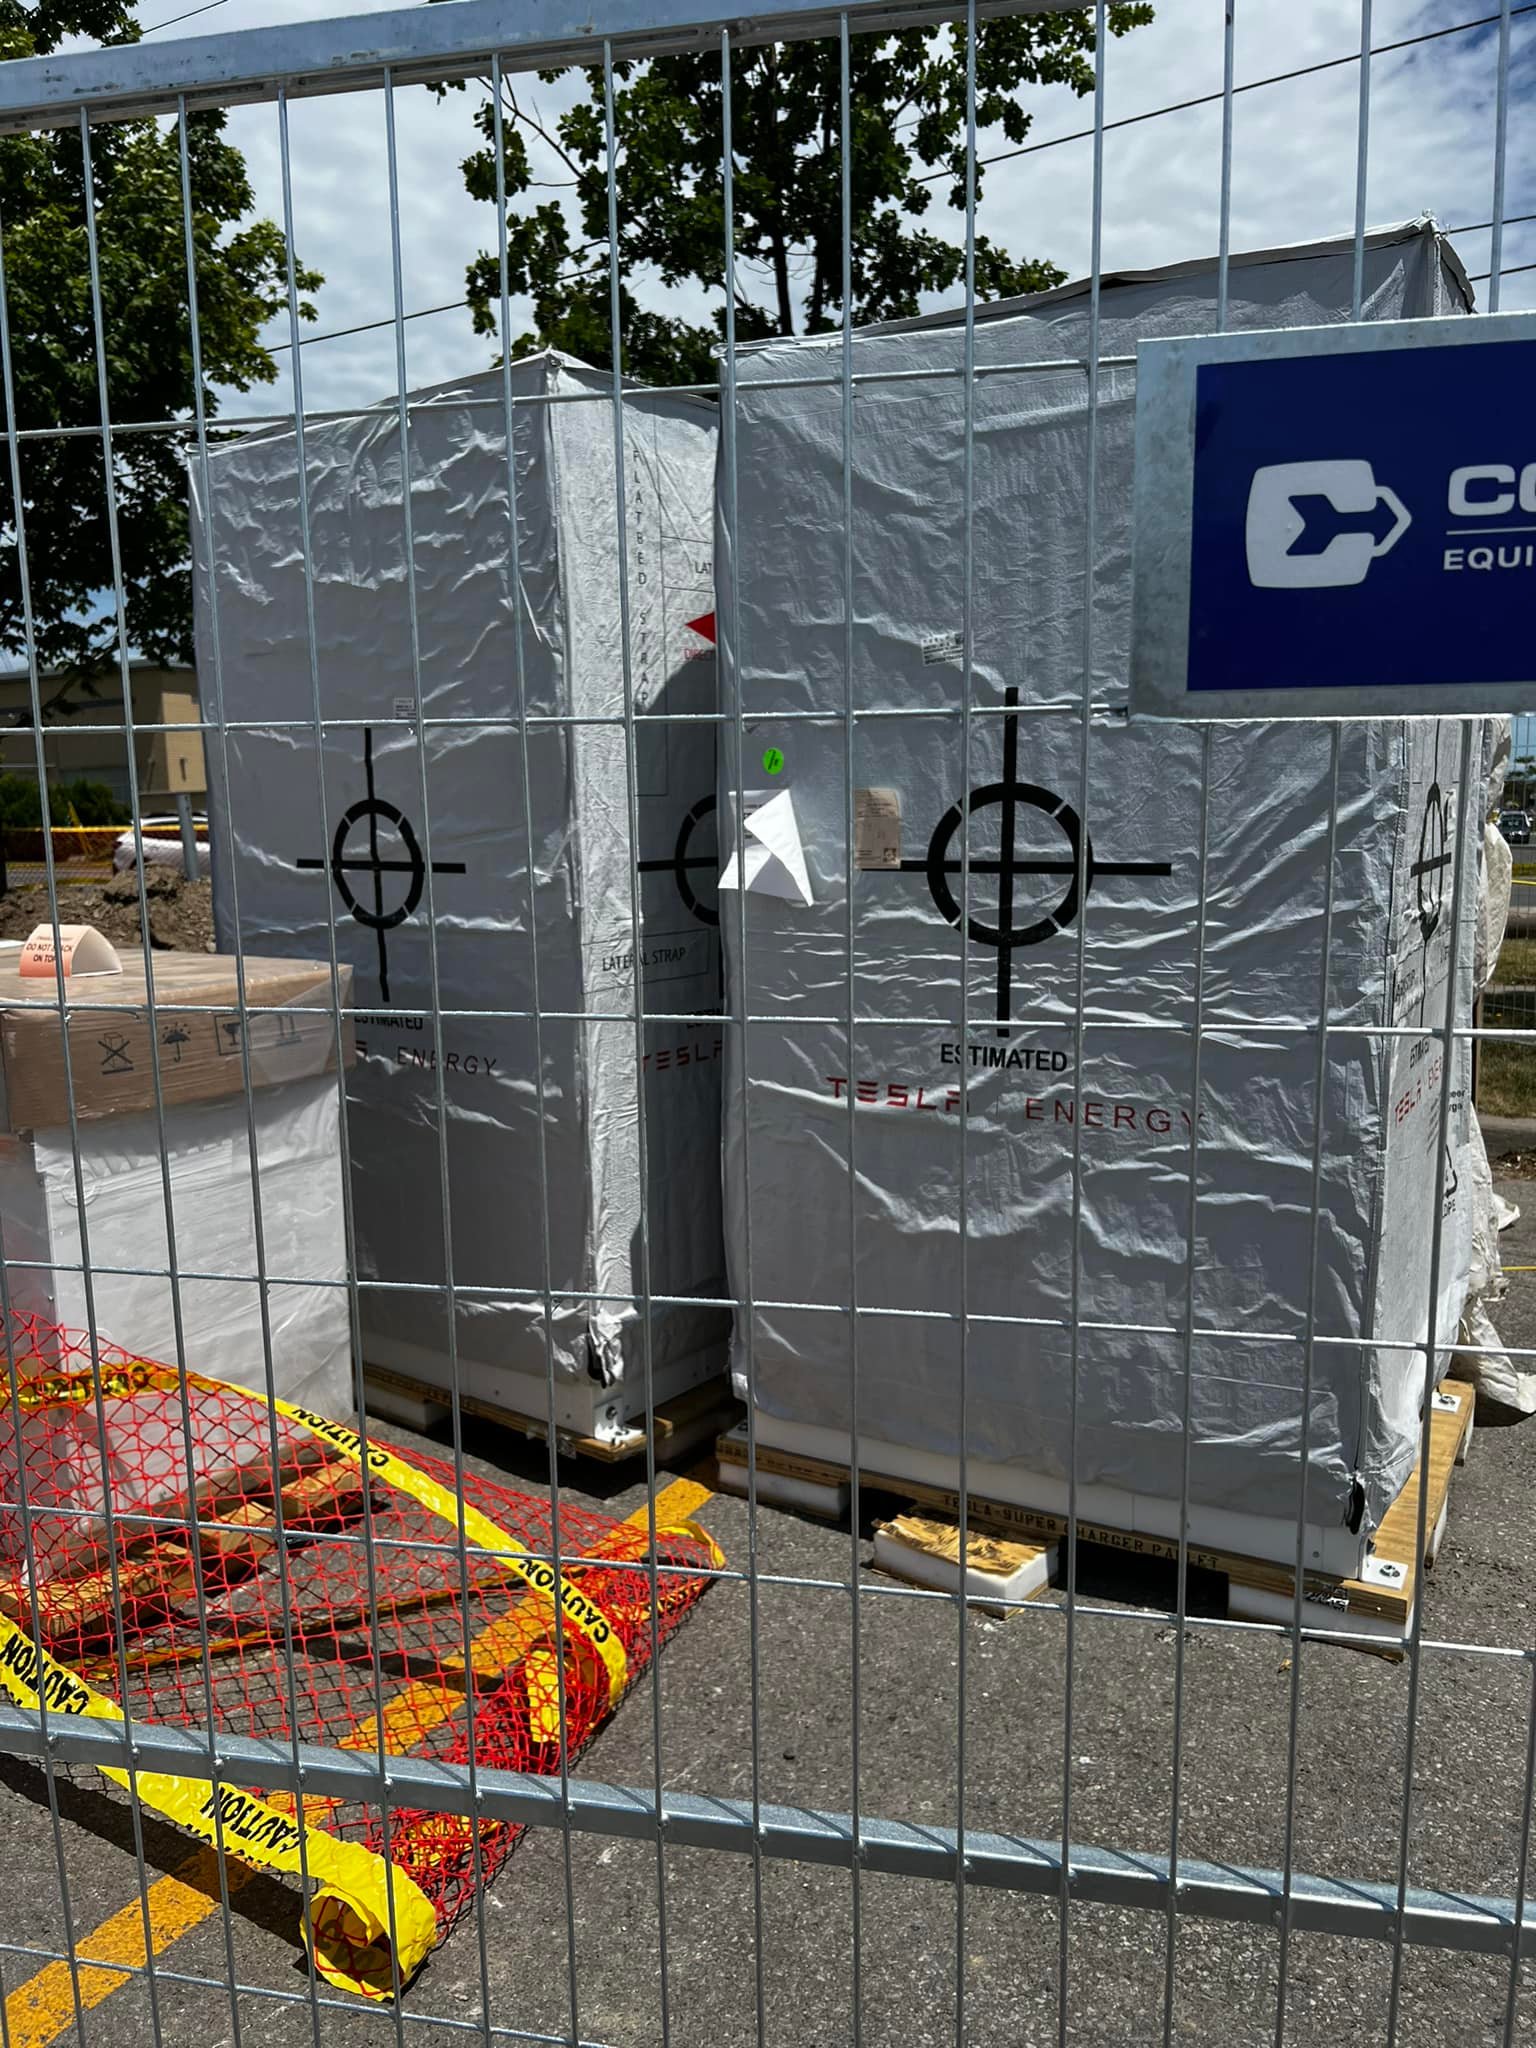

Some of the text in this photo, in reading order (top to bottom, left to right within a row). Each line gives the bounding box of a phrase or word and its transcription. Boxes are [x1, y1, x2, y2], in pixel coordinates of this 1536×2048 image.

[1448, 463, 1536, 516] C
[1443, 546, 1534, 571] EQUI
[33, 954, 42, 962] ON
[37, 944, 51, 952] NOT
[51, 945, 73, 953] SCK
[652, 947, 685, 965] STRAP
[397, 1046, 496, 1076] ENERGY
[941, 1043, 1067, 1072] ESTIMATED
[1025, 1096, 1204, 1137] ENERGY
[3, 1633, 90, 1715] CAUTION
[200, 1787, 309, 1854] CAUTION
